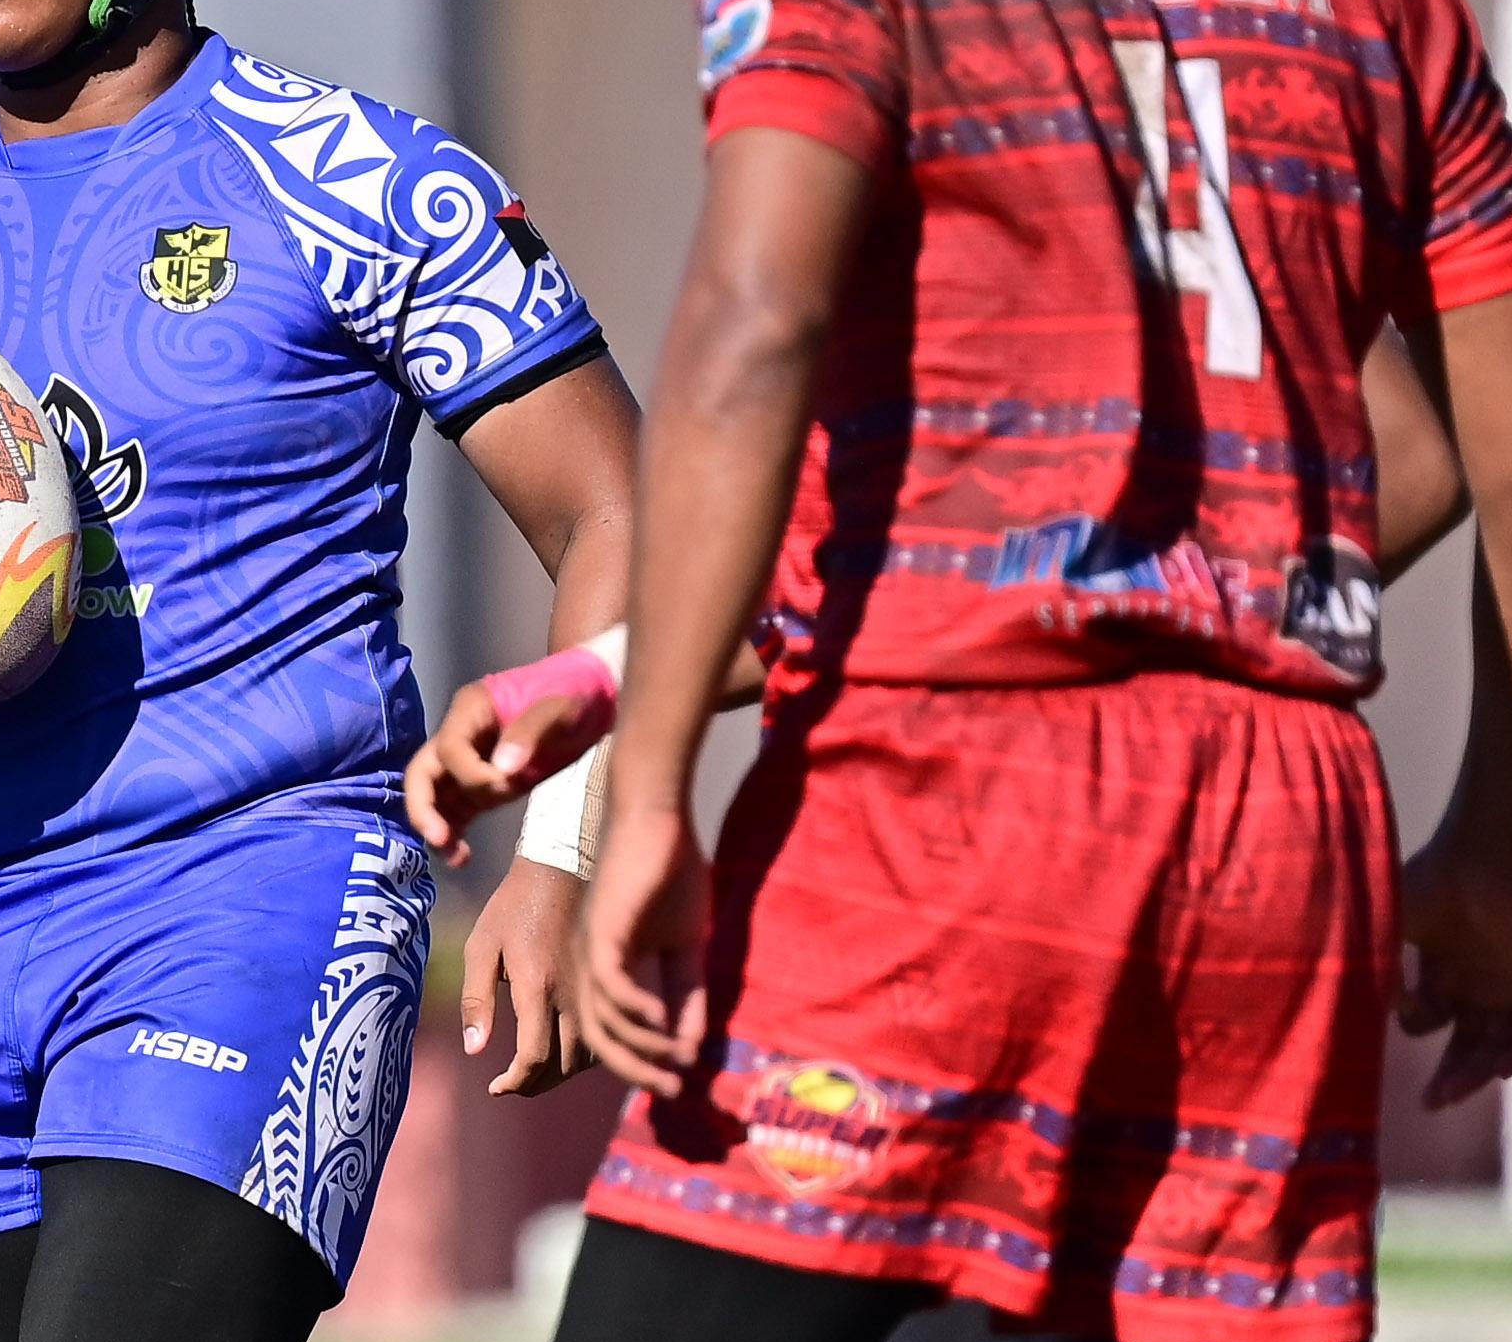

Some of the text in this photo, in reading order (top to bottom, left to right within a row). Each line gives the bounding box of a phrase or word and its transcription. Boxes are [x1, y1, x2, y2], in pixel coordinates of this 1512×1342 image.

[1108, 37, 1266, 380] 4
[76, 582, 155, 620] ow
[126, 1027, 249, 1074] HSBP
